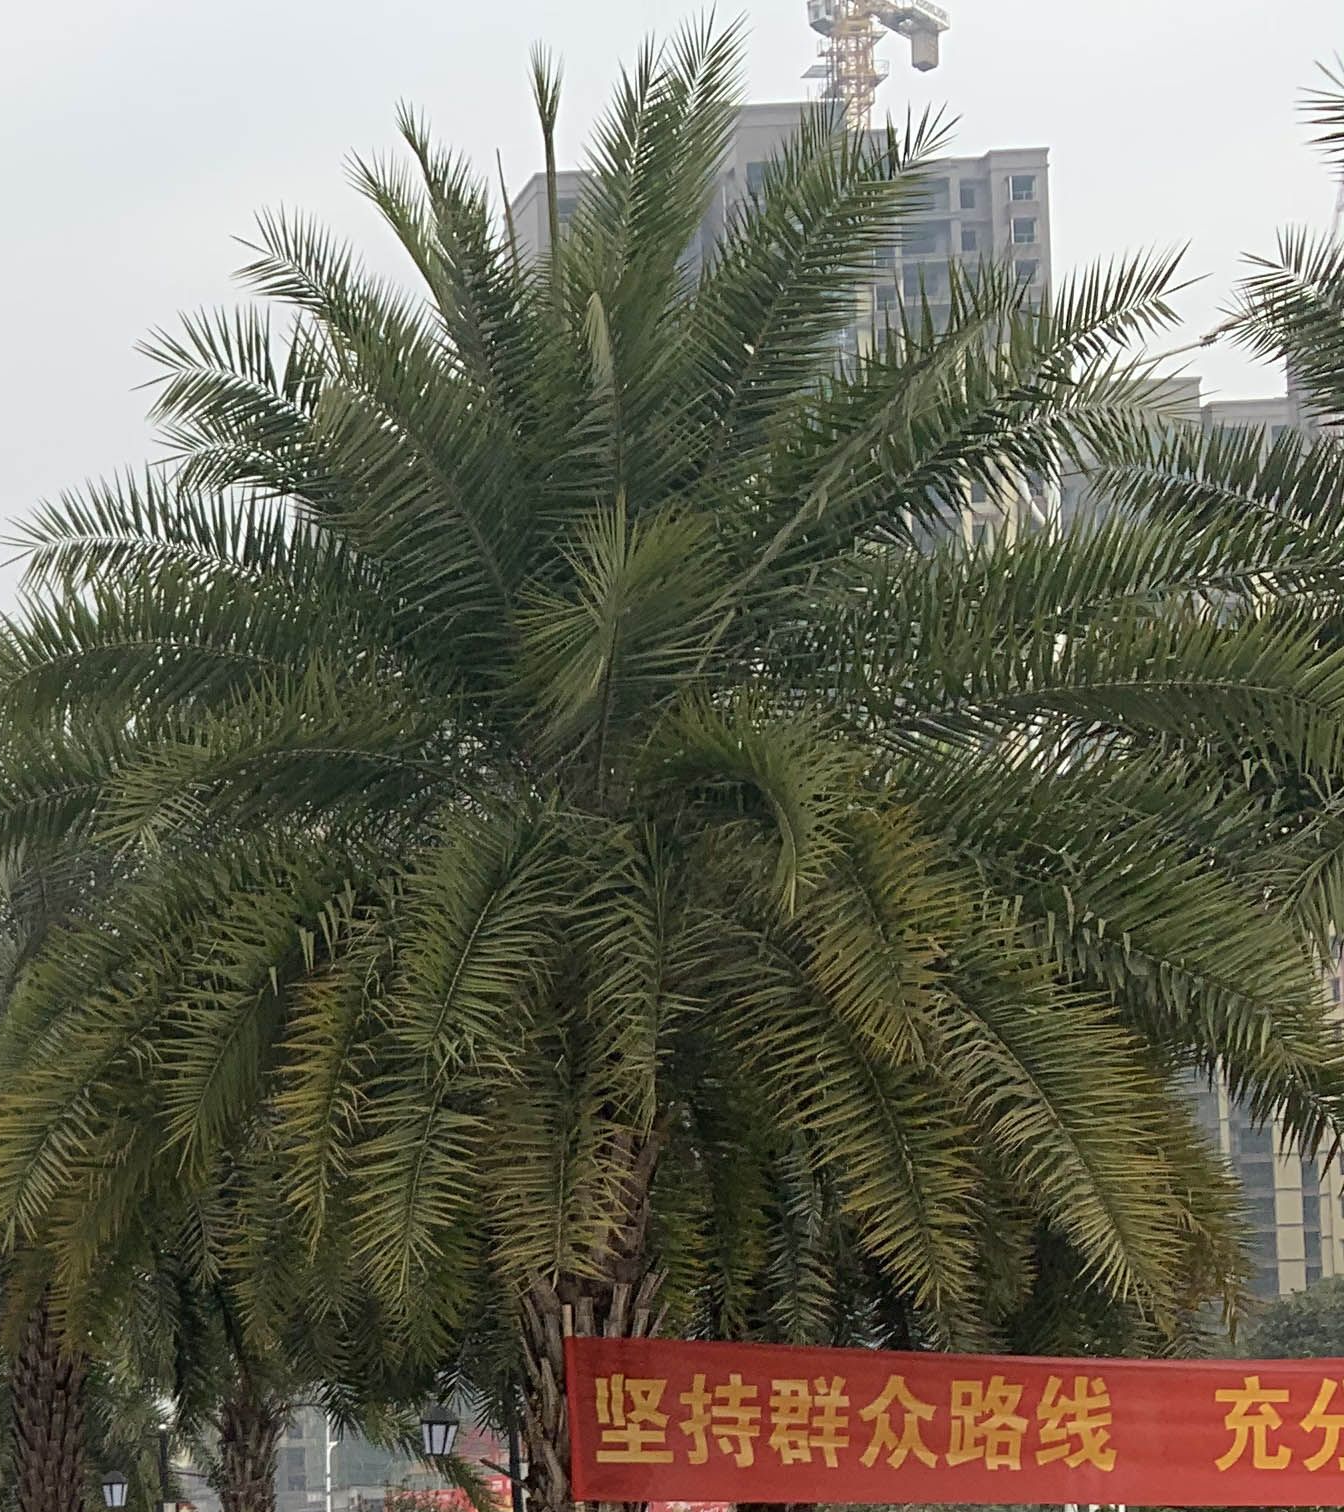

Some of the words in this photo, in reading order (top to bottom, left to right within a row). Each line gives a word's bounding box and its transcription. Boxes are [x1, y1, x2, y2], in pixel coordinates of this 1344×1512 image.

[595, 1373, 1117, 1471] 坚持群众路线
